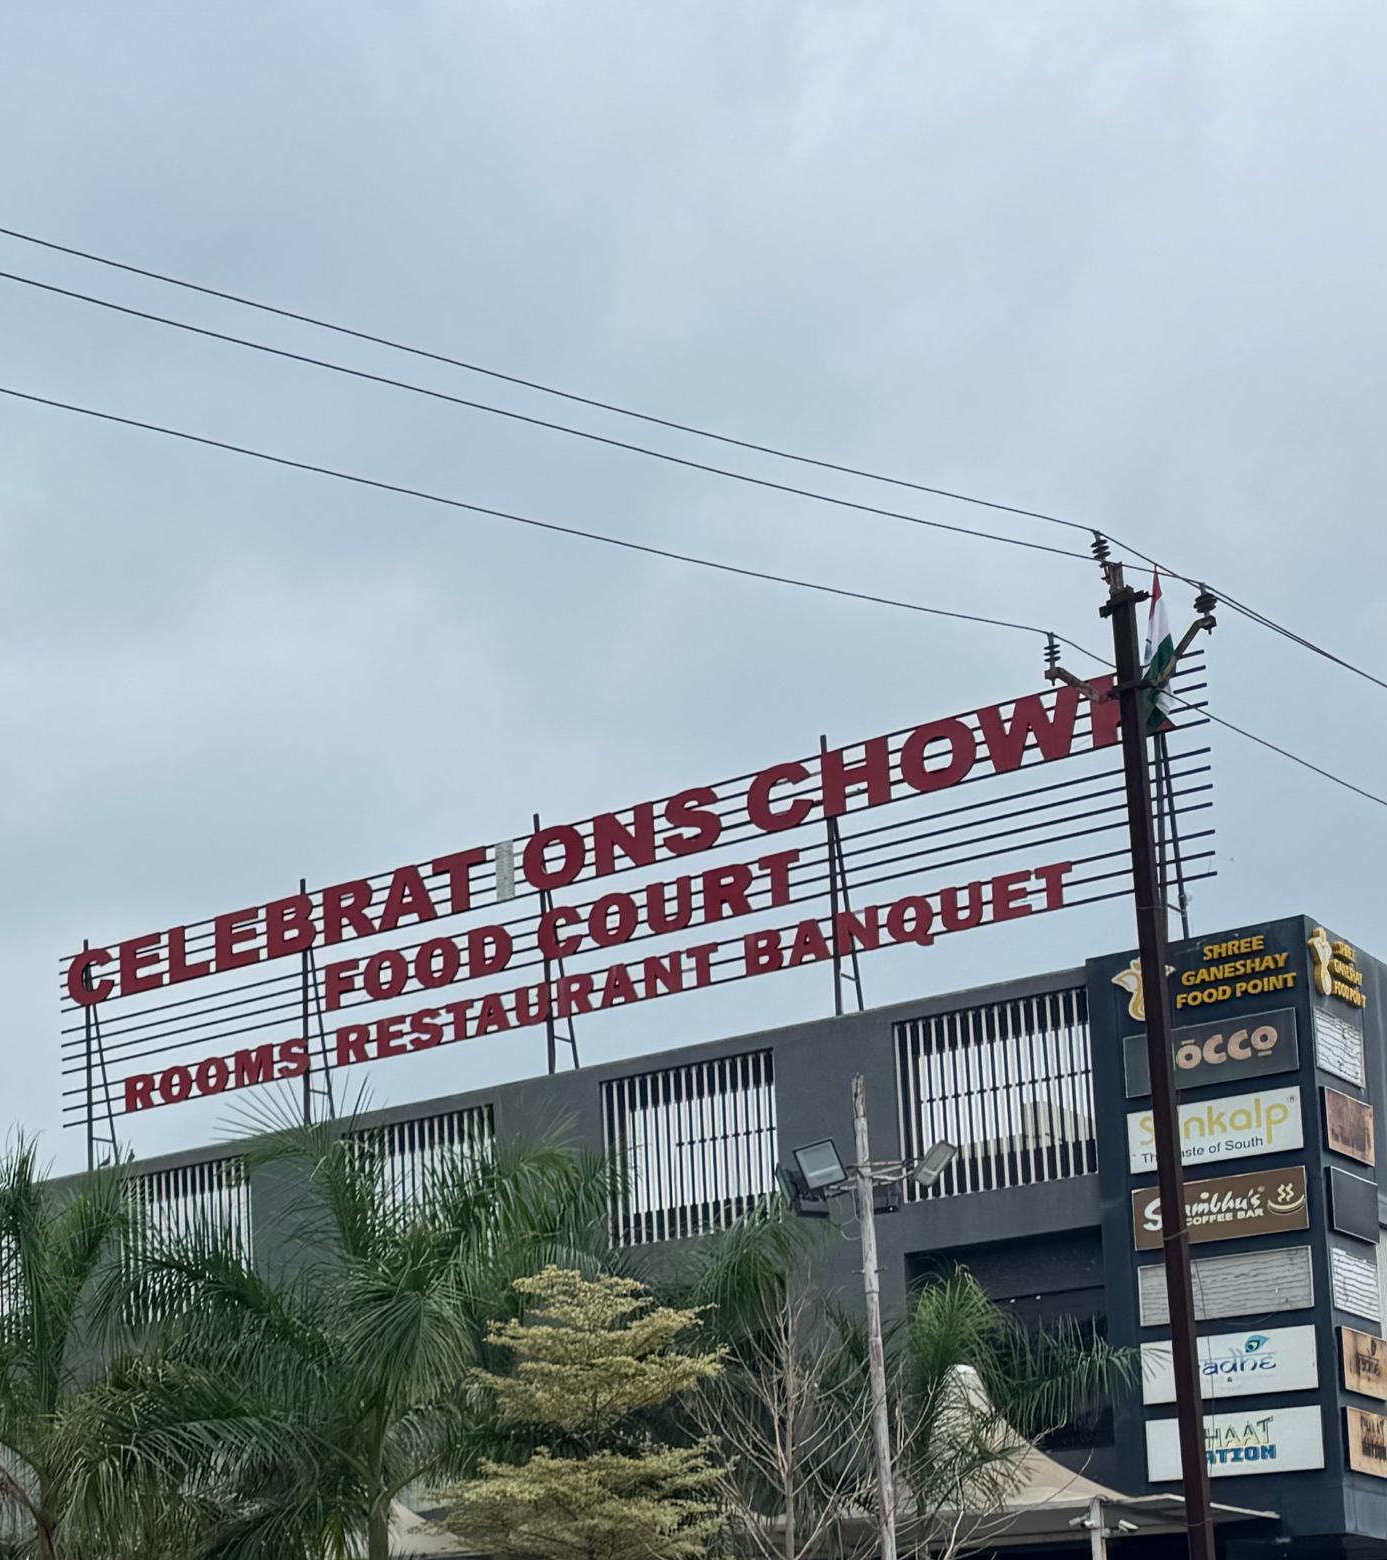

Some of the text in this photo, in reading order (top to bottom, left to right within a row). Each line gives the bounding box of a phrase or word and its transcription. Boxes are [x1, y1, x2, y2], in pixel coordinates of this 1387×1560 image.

[67, 786, 723, 1007] CELEBRATIONS
[324, 849, 800, 1012] FOOD COURT
[1202, 935, 1264, 961] SHREE
[124, 861, 1073, 1114] ROOMS RESTAURANT BANQUET
[1181, 952, 1289, 987] GANESHAY
[1175, 971, 1298, 1009] FOOD POINT
[1139, 1098, 1289, 1147] Snkalp
[1141, 1151, 1159, 1165] Th
[1209, 1141, 1221, 1155] of
[1225, 1136, 1264, 1151] South
[1236, 1208, 1265, 1221] BAR
[1205, 1416, 1274, 1450] HAAT
